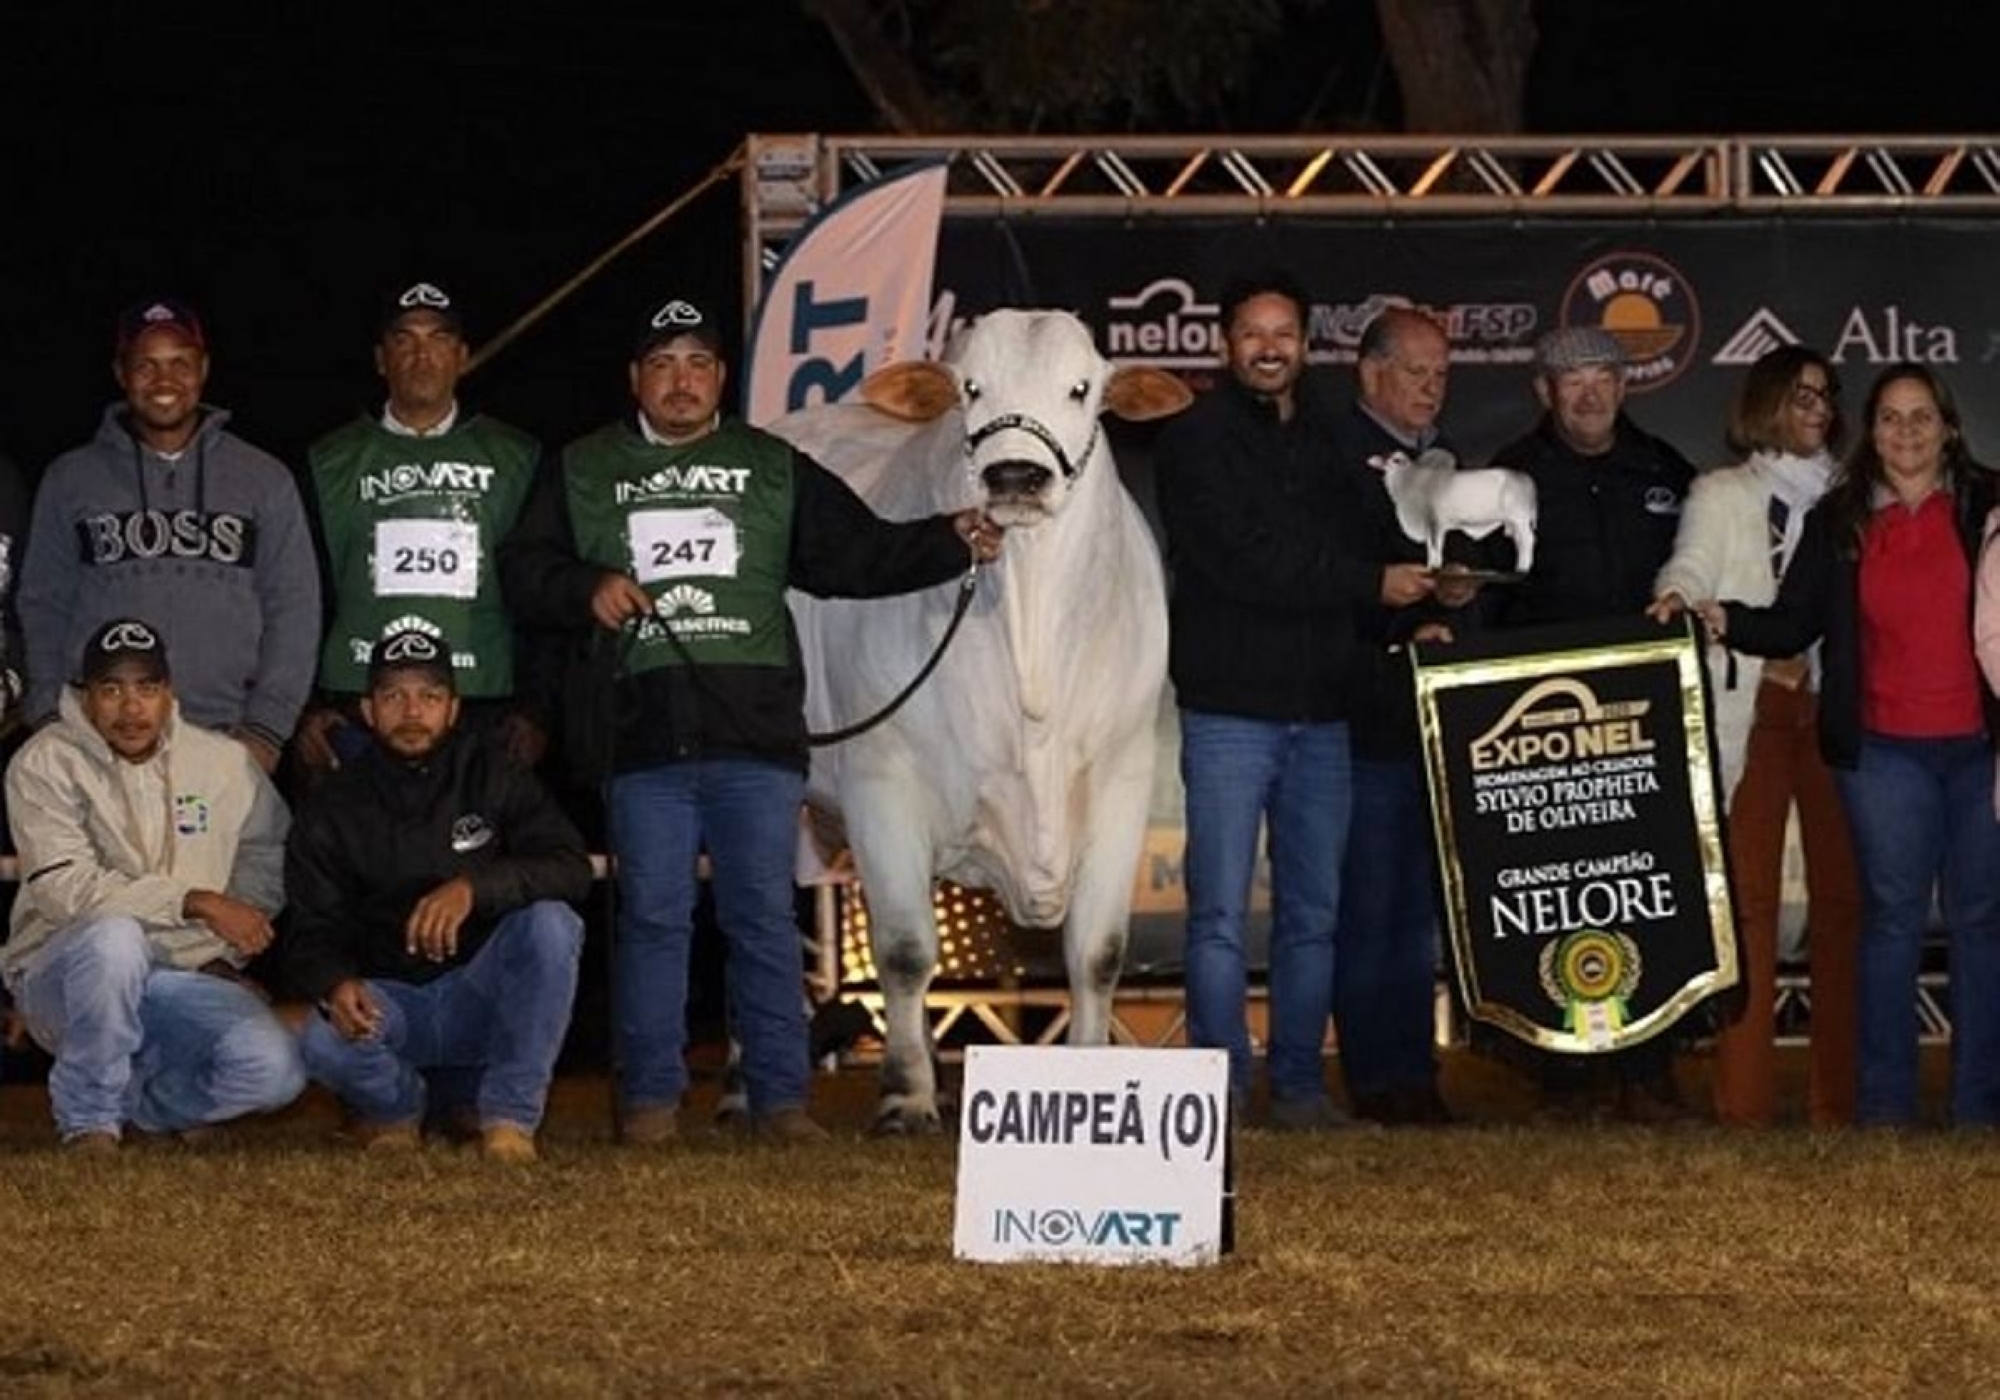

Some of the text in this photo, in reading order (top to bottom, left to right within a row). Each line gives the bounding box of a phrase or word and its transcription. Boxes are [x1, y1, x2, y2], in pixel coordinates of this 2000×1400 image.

[1830, 304, 1959, 362] Alta
[361, 462, 495, 501] INOVART
[615, 465, 751, 505] INOVART
[87, 510, 244, 562] BOSS
[652, 538, 716, 568] 247
[394, 546, 459, 575] 250
[1475, 771, 1660, 813] SYLVIO PROPHETA
[1506, 799, 1637, 833] DE OLIVEIRA
[1498, 851, 1654, 887] GRANDE CAMPEÃO
[1490, 872, 1677, 938] NELORE
[968, 1080, 1218, 1162] CAMPEÃ (O)
[994, 1209, 1182, 1246] INOVART
